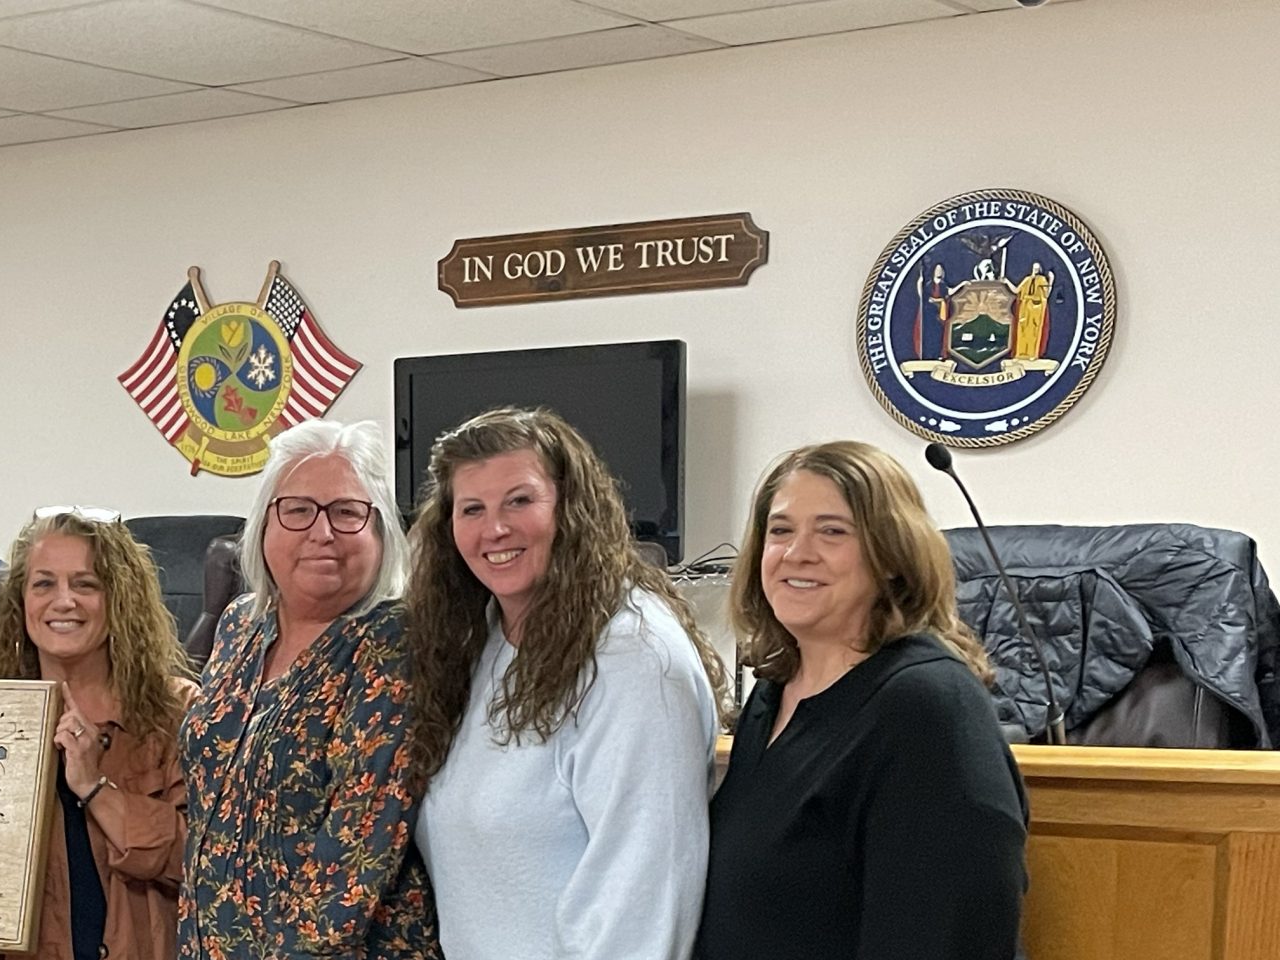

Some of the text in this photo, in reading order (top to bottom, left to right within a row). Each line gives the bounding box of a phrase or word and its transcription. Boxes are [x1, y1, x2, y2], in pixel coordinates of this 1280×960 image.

[462, 234, 735, 283] IN GOD WE TRUST
[868, 202, 1103, 374] THE GREAT SEAL OF THE STATE OF NEW YORK
[202, 304, 264, 326] VILLAGE OF
[179, 365, 215, 435] GREENWOOD
[263, 400, 285, 428] NEW
[282, 356, 291, 394] YORK
[942, 371, 1014, 385] EXCELSIOR
[231, 455, 254, 465] SPIRIT
